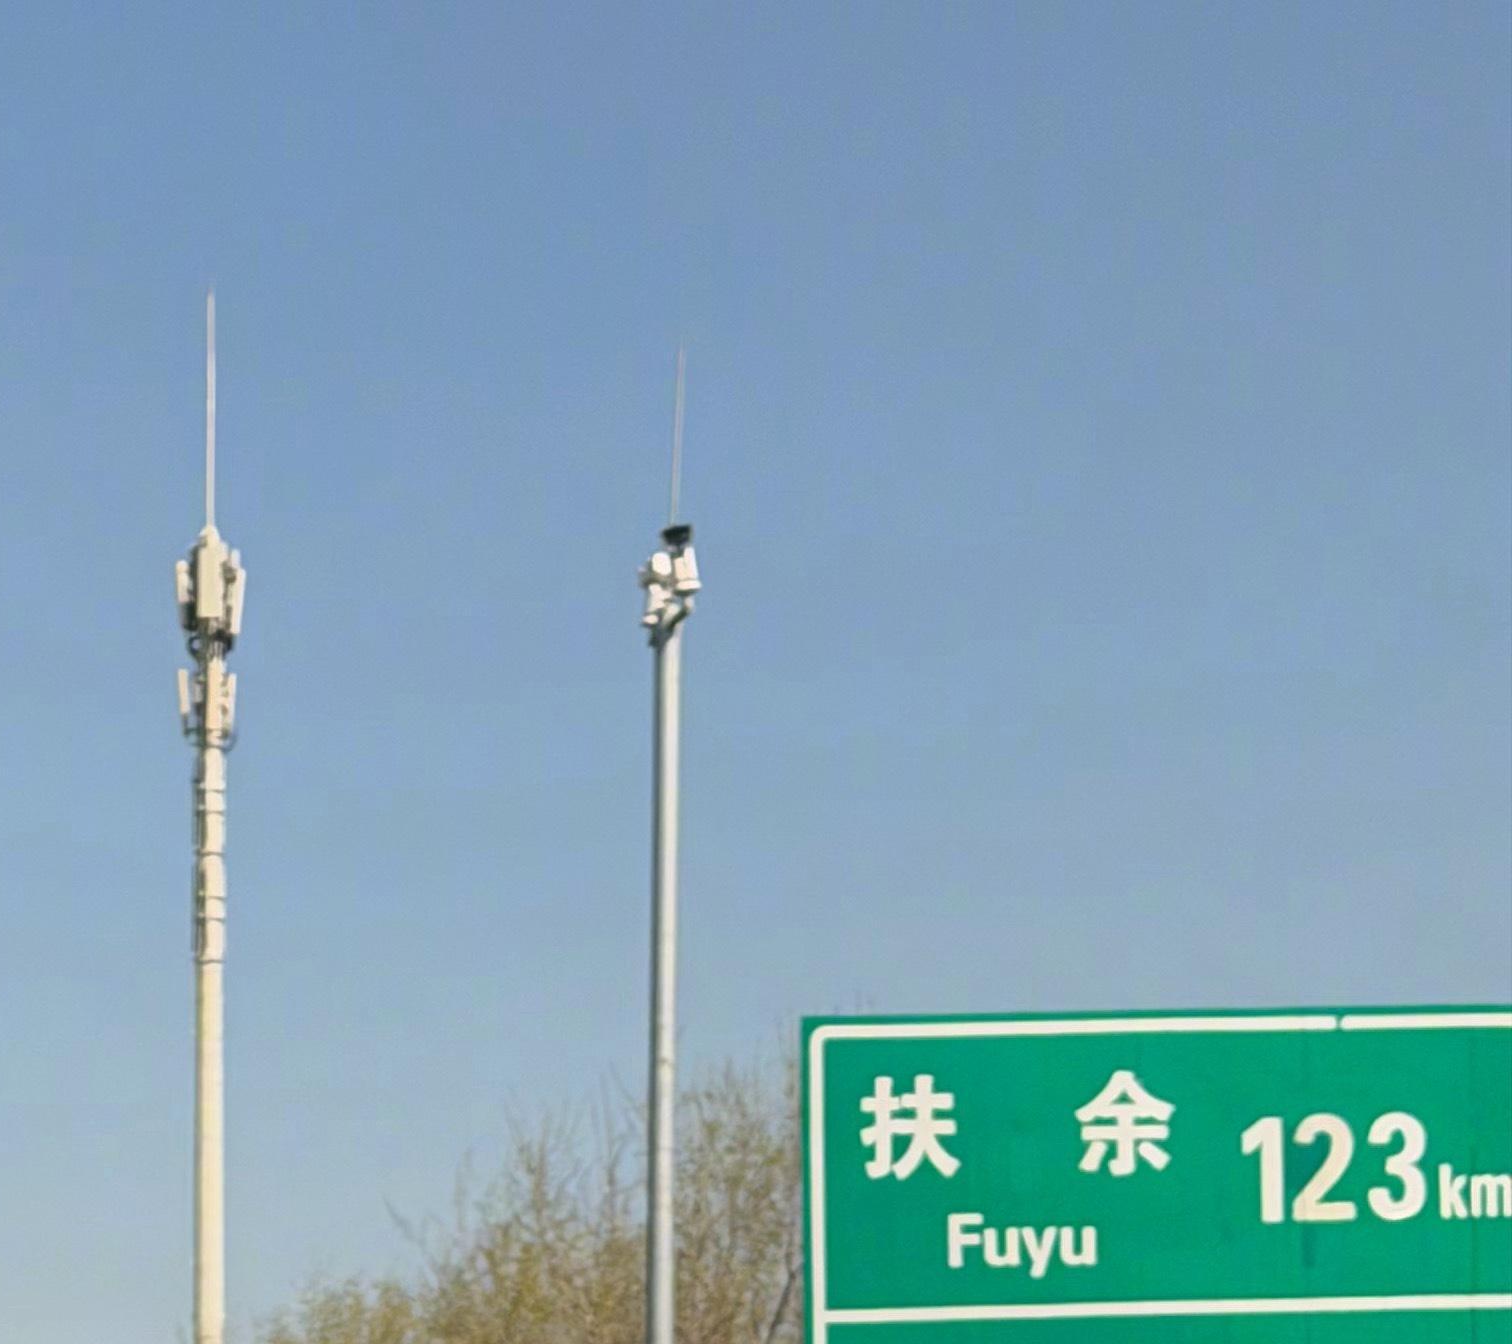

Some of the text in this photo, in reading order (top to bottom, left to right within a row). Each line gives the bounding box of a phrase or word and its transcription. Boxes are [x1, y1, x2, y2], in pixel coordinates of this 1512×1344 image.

[1240, 1111, 1428, 1224] 123
[1438, 1163, 1512, 1221] km
[947, 1212, 1098, 1279] Fuyu
